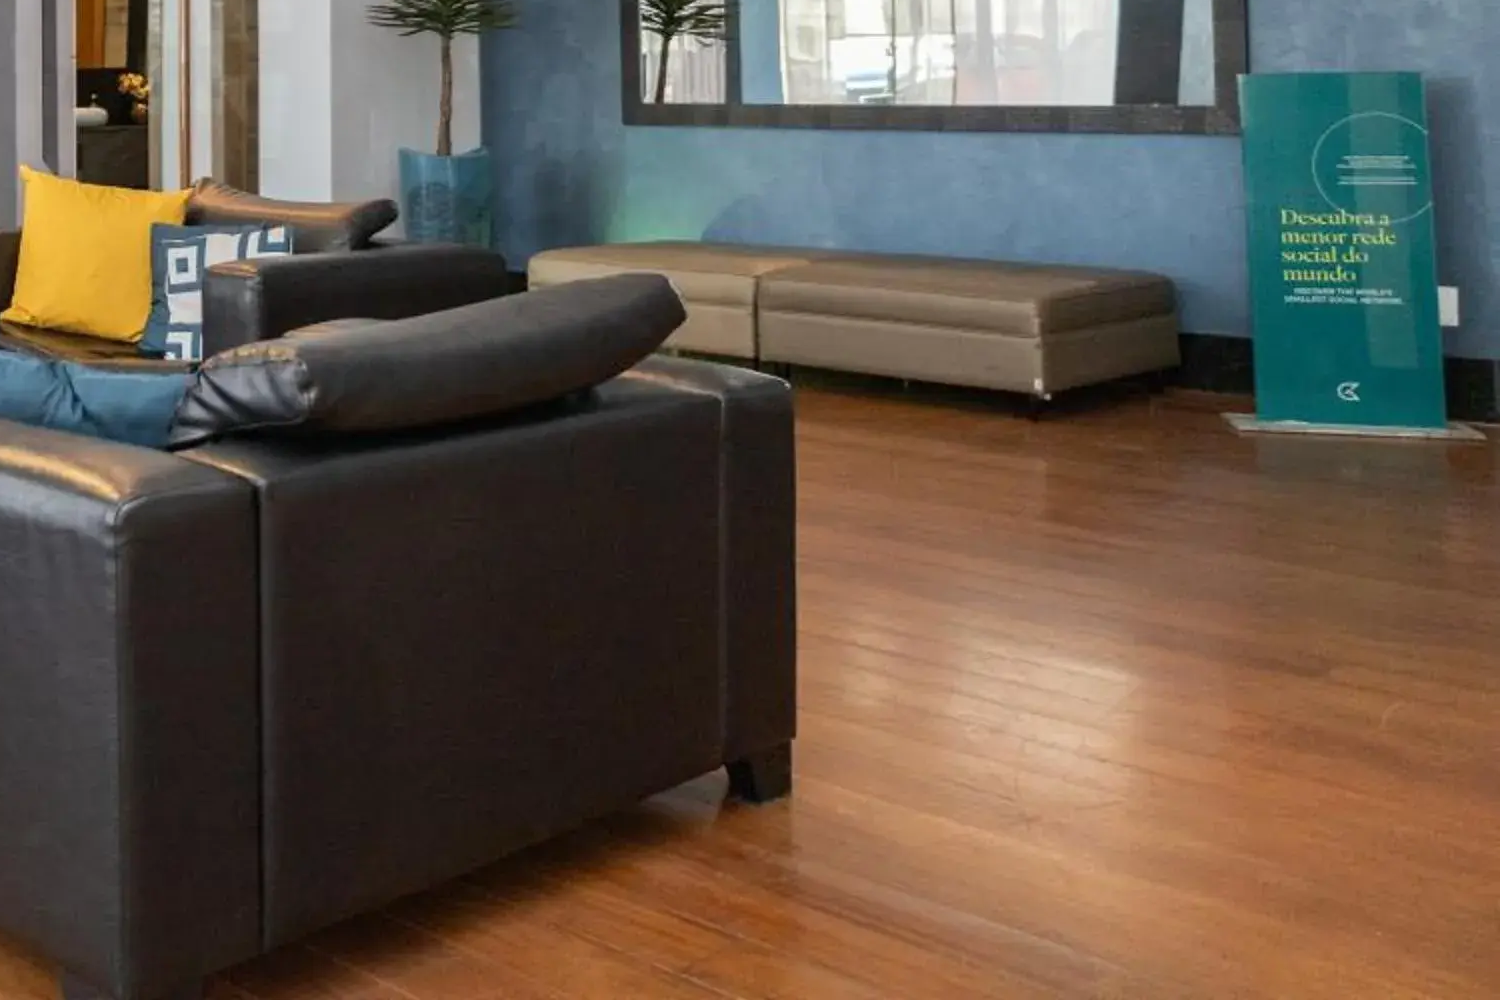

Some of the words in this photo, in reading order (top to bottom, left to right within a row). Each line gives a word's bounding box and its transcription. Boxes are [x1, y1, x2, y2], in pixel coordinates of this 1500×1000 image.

[1281, 208, 1375, 225] Descubra
[1379, 213, 1390, 225] a
[1281, 231, 1348, 244] menor
[1352, 228, 1397, 245] rede
[1281, 246, 1337, 263] social
[1342, 246, 1369, 263] do
[1283, 265, 1357, 281] mundo
